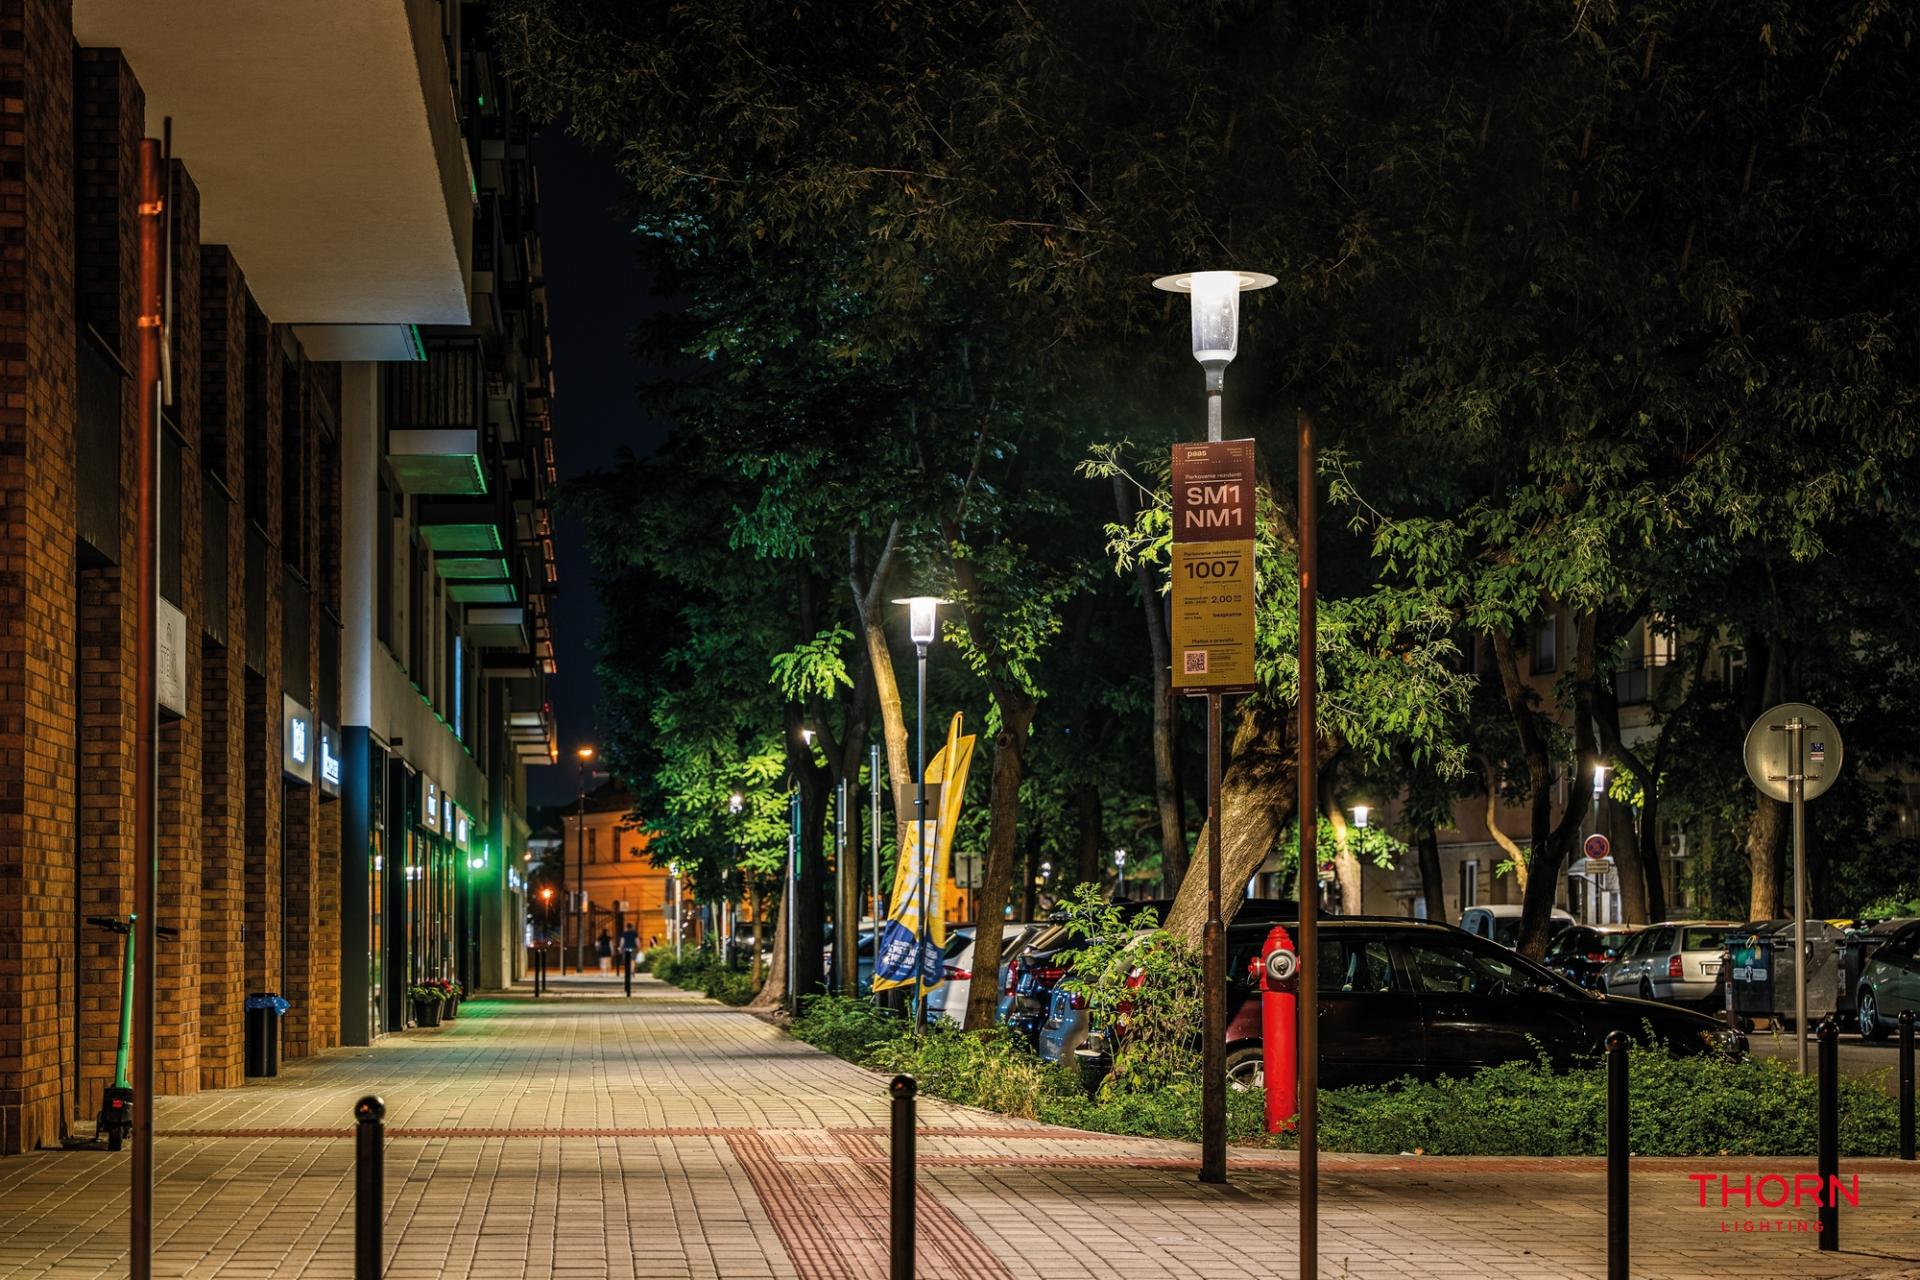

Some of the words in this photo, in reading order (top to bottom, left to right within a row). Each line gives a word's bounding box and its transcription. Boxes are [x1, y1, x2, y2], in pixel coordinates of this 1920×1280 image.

[1187, 450, 1207, 459] paas
[1187, 485, 1240, 505] SM1
[1185, 508, 1242, 528] NM1
[1184, 560, 1240, 579] 1007
[1211, 594, 1233, 604] 2.00
